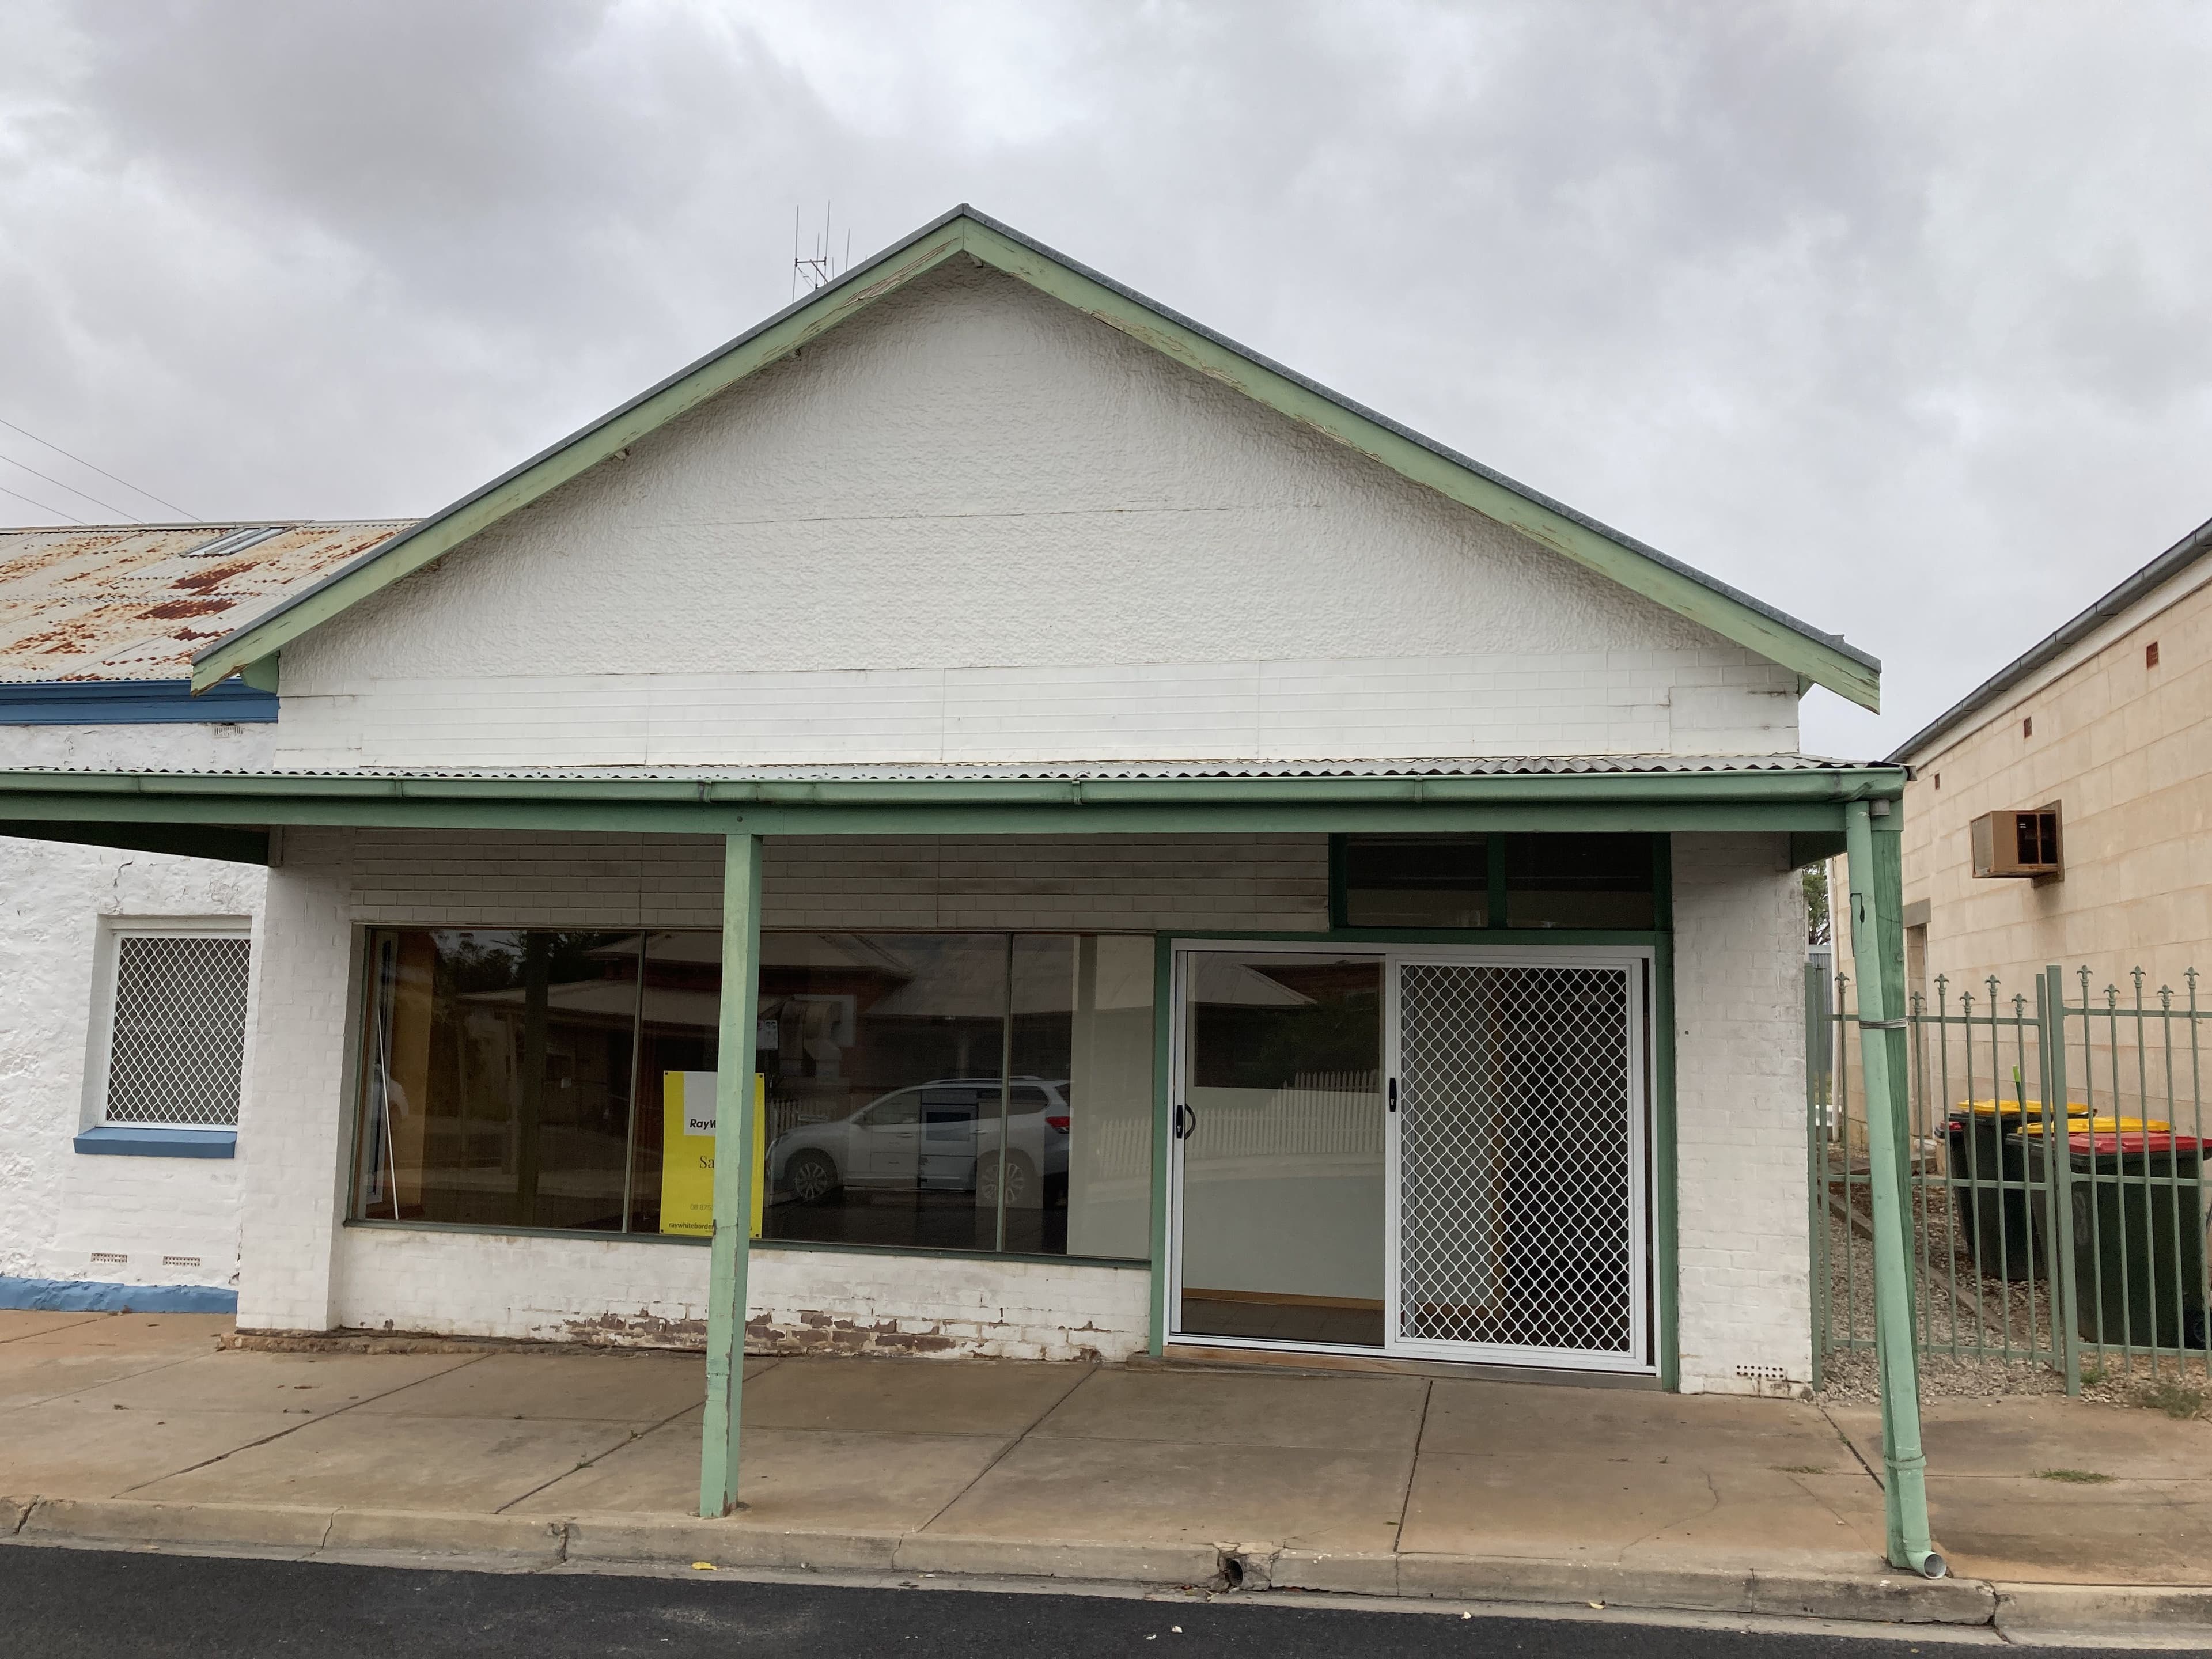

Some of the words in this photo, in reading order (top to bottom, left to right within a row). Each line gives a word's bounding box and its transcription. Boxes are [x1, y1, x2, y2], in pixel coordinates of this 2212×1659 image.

[690, 1119, 716, 1130] RayW
[700, 1156, 715, 1169] Sa
[669, 1221, 714, 1230] raywhiteborder
